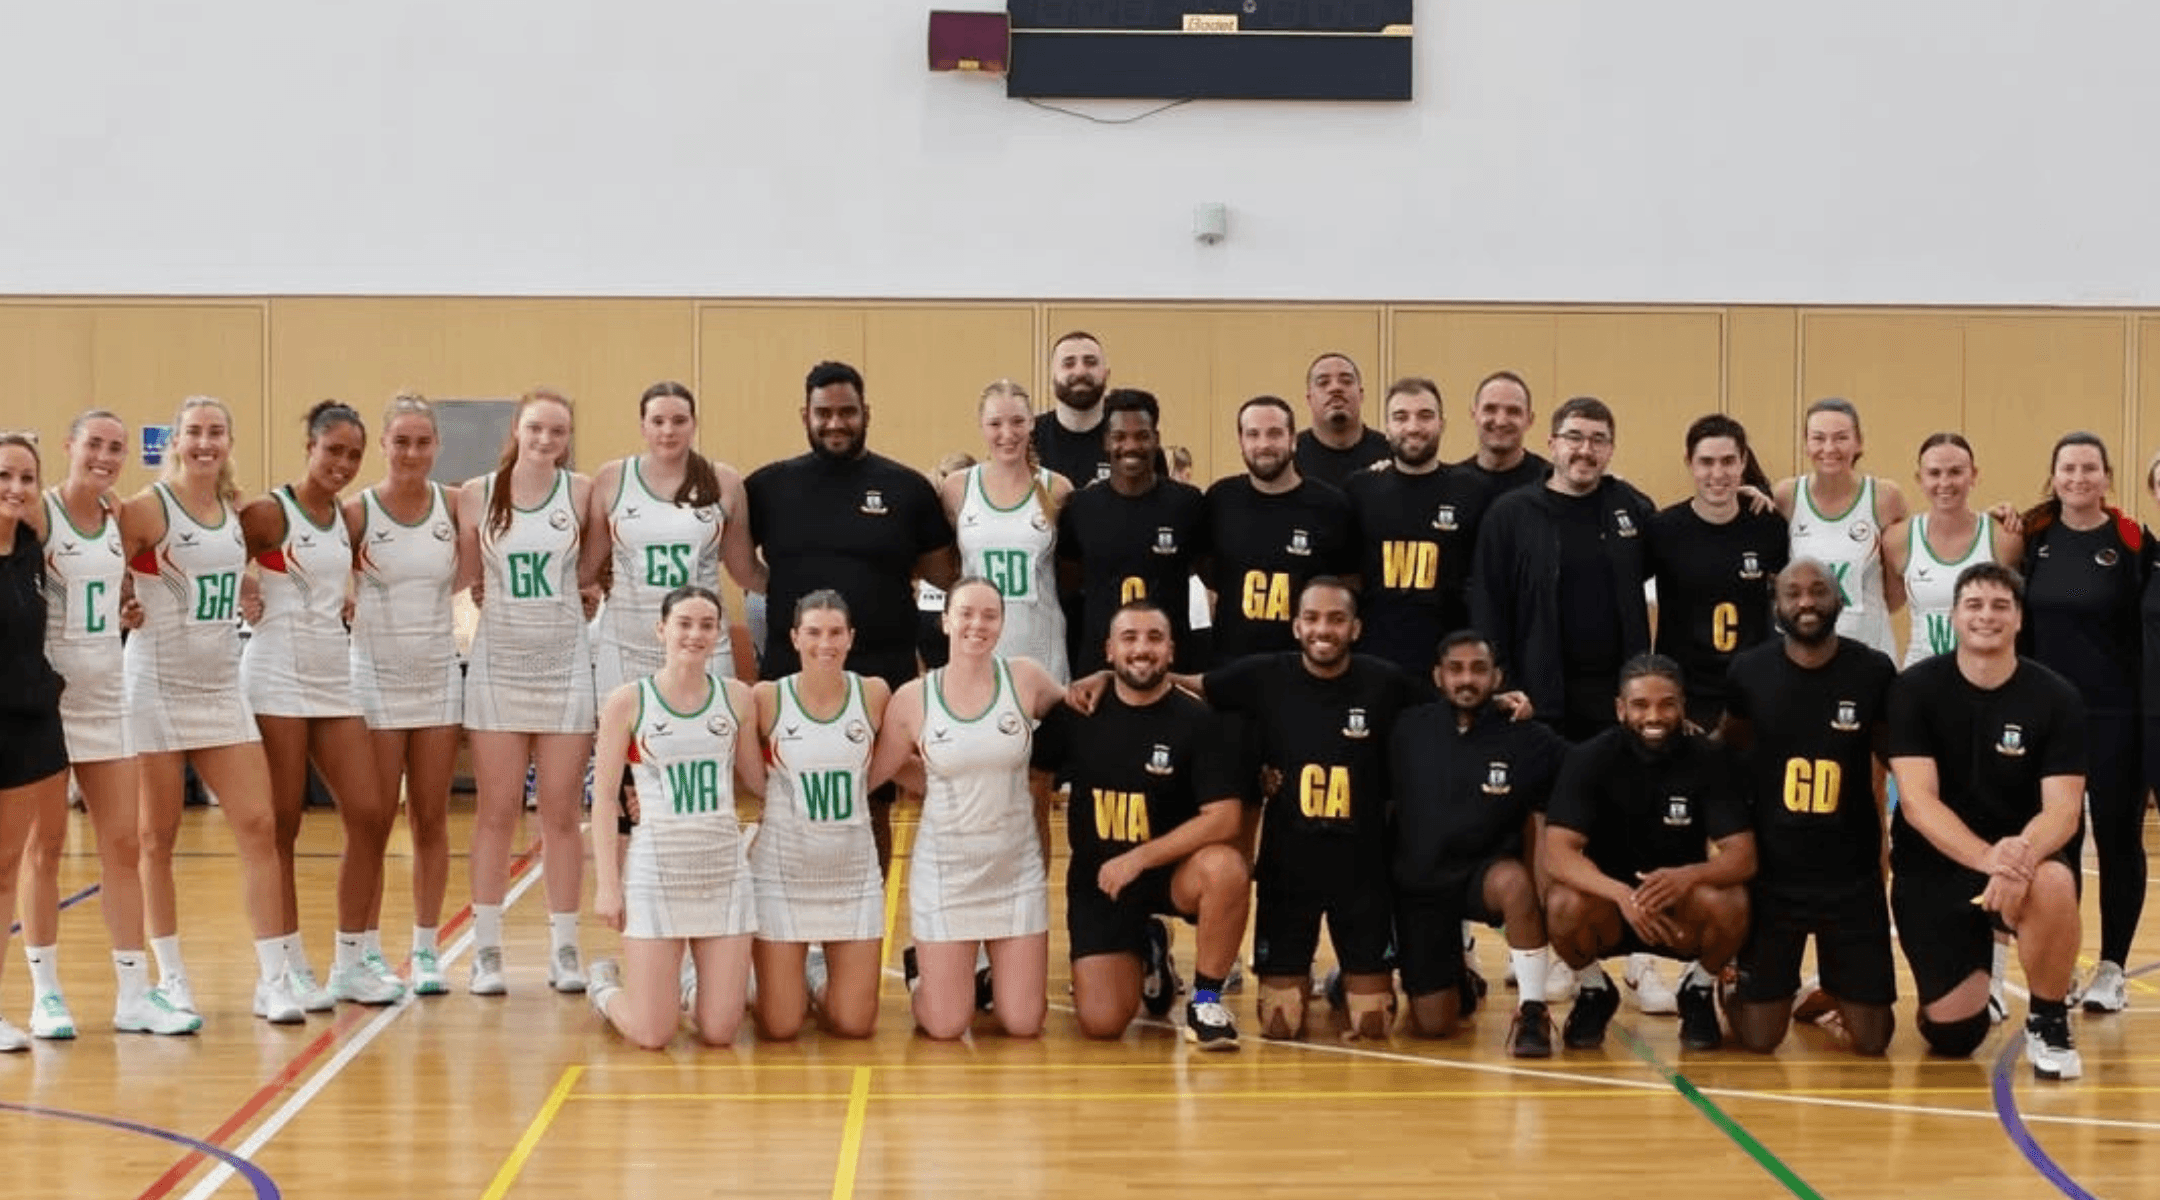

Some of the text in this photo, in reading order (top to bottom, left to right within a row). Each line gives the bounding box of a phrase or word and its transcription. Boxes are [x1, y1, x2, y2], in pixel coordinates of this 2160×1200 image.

[508, 551, 554, 599] GK
[645, 543, 691, 587] GS
[983, 549, 1028, 597] GD
[1382, 540, 1439, 590] WD
[1829, 561, 1852, 608] K
[85, 581, 106, 633] C
[196, 572, 236, 621] GA
[1242, 570, 1290, 621] GA
[1713, 602, 1739, 652] C
[1926, 613, 1957, 656] W
[666, 760, 719, 814] WA
[801, 771, 853, 822] WD
[1300, 763, 1351, 818] GA
[1783, 757, 1841, 813] GD
[1092, 788, 1151, 842] WA
